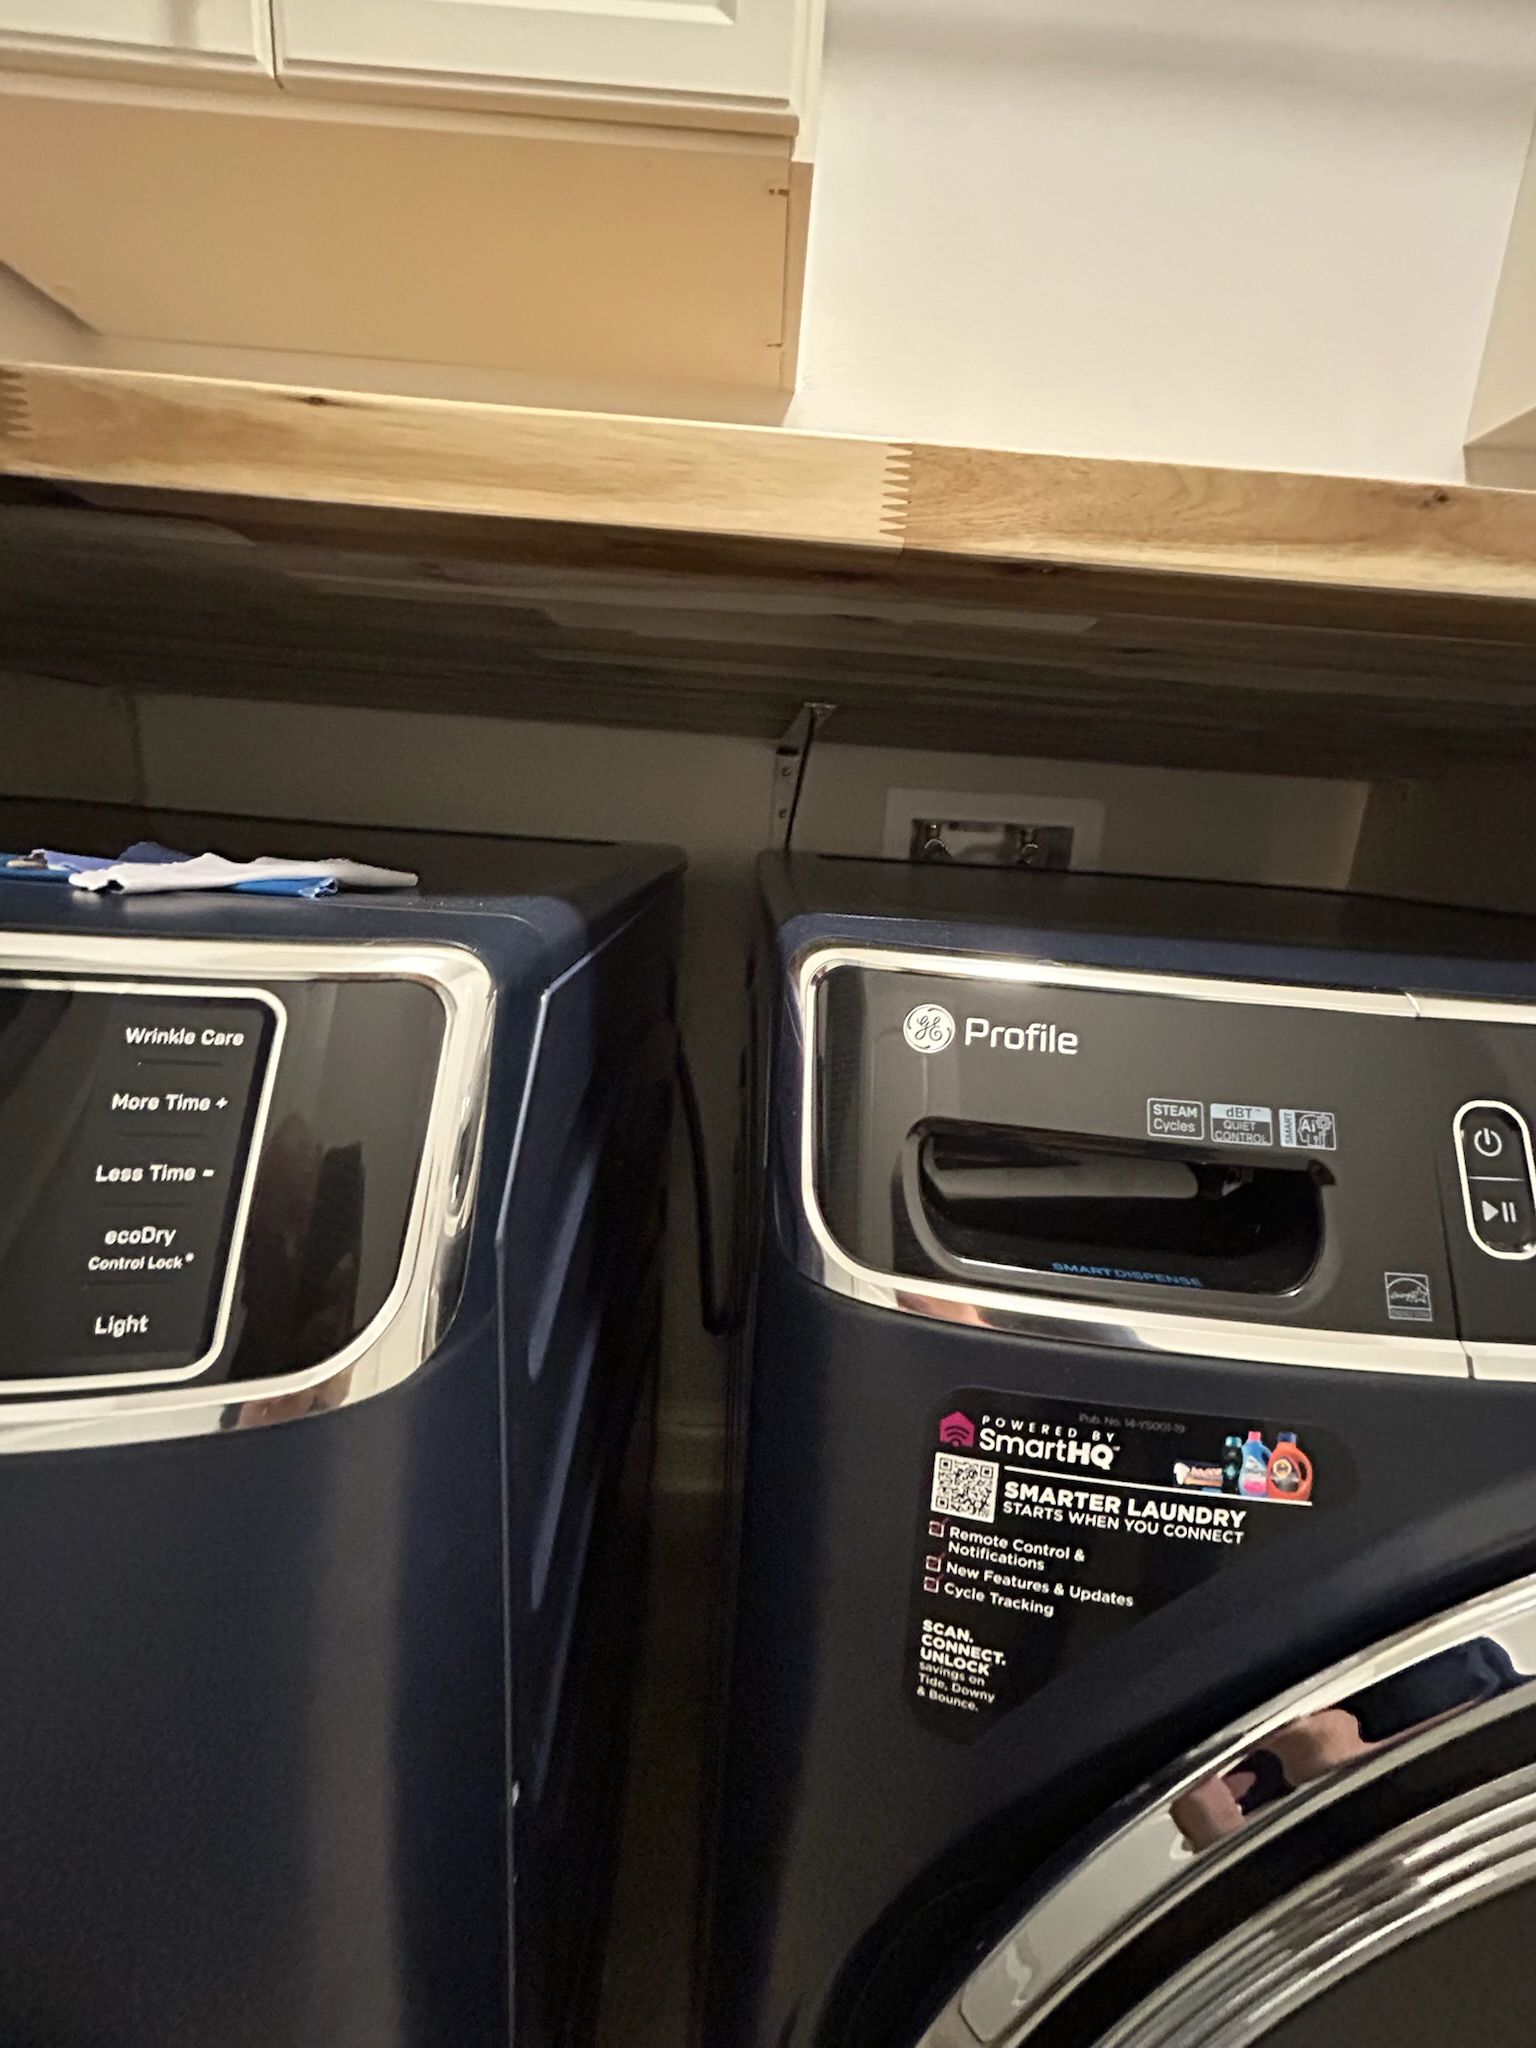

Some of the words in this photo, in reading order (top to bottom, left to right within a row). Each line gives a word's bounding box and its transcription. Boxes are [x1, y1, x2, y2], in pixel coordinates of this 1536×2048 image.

[125, 1027, 196, 1046] Wrinkle
[200, 1029, 244, 1046] Care
[964, 1017, 1079, 1055] Profile
[111, 1093, 160, 1111] More
[165, 1094, 211, 1111] Time
[1152, 1103, 1198, 1119] STEAM
[1153, 1118, 1196, 1134] Cycles
[1214, 1131, 1269, 1145] CONTROL
[1223, 1120, 1256, 1132] QUIET
[1284, 1112, 1293, 1145] SMART
[95, 1165, 143, 1182] Less
[149, 1165, 196, 1182] Time
[104, 1226, 176, 1246] ecoDry
[88, 1256, 145, 1271] Control
[1052, 1262, 1112, 1277] SMART
[1113, 1268, 1204, 1288] DISPENSE
[94, 1314, 149, 1338] Light
[982, 1414, 1078, 1439] POWERED
[1091, 1430, 1115, 1443] BY
[1004, 1481, 1122, 1515] SMARTER
[1127, 1498, 1247, 1529] LAUNDRY
[1003, 1501, 1064, 1523] STARTS
[1068, 1511, 1120, 1531] WHEN
[1124, 1518, 1160, 1536] YOU
[1163, 1523, 1245, 1545] CONNECT
[948, 1541, 1046, 1572] Notifications
[949, 1526, 1009, 1550] Remote
[1012, 1538, 1070, 1561] Control
[1074, 1548, 1086, 1563] &
[946, 1561, 980, 1580] New
[983, 1569, 1050, 1595] Features
[1053, 1582, 1065, 1597] &
[1068, 1585, 1135, 1608] Updates
[944, 1582, 986, 1602] Cycle
[989, 1591, 1055, 1618] Tracking
[922, 1619, 974, 1644] SCAN.
[920, 1646, 991, 1677] UNLOCK
[921, 1633, 1007, 1667] CONNECT.
[918, 1671, 949, 1692] Tide,
[951, 1682, 996, 1704] Downy
[919, 1661, 966, 1682] savings
[968, 1675, 986, 1687] on
[916, 1685, 926, 1697] &
[928, 1688, 980, 1713] Bounce.
